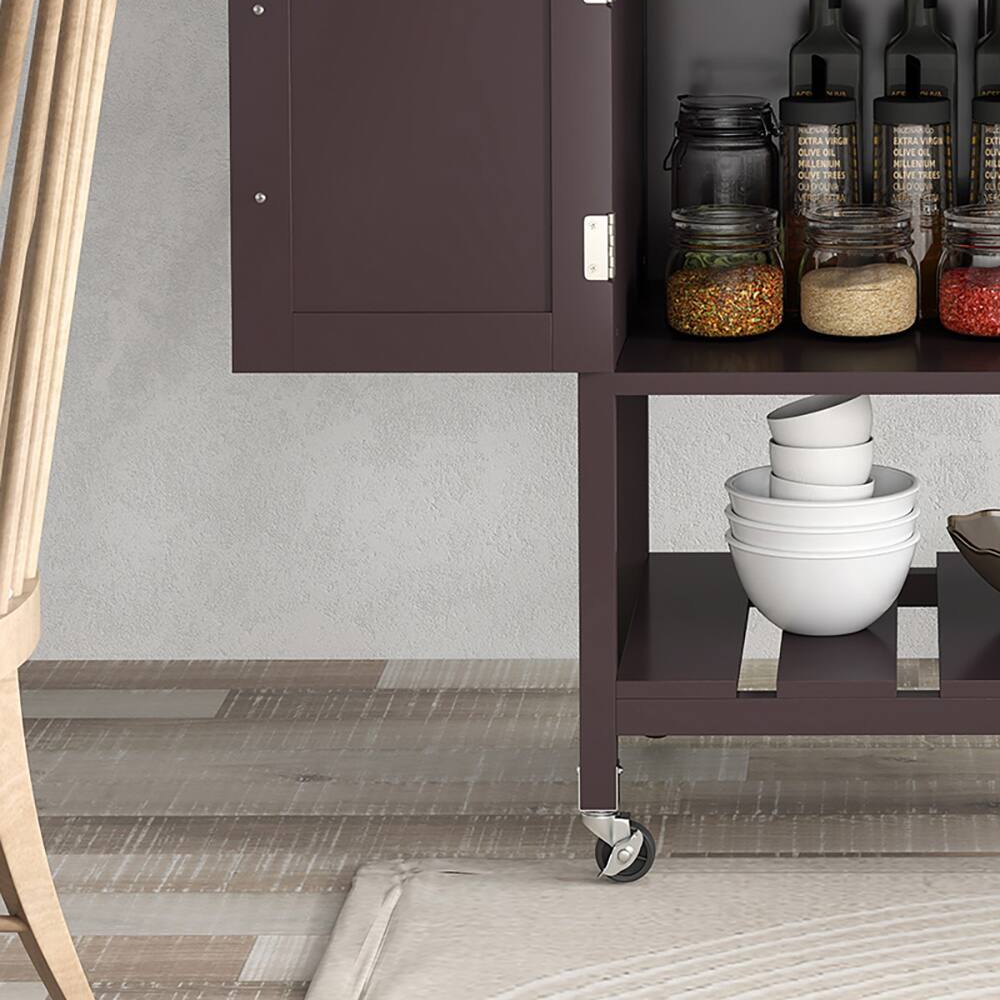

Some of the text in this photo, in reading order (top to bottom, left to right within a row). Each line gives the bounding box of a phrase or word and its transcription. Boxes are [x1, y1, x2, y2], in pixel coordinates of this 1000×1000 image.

[798, 137, 848, 145] EXTRA VIRGIN
[893, 137, 944, 145] EXTRA VIRGIN
[798, 148, 835, 157] OLIVE OIL
[893, 148, 931, 157] OLIVE OIL
[798, 171, 846, 180] OLIVE TREES
[893, 171, 941, 180] OLIVE TREES
